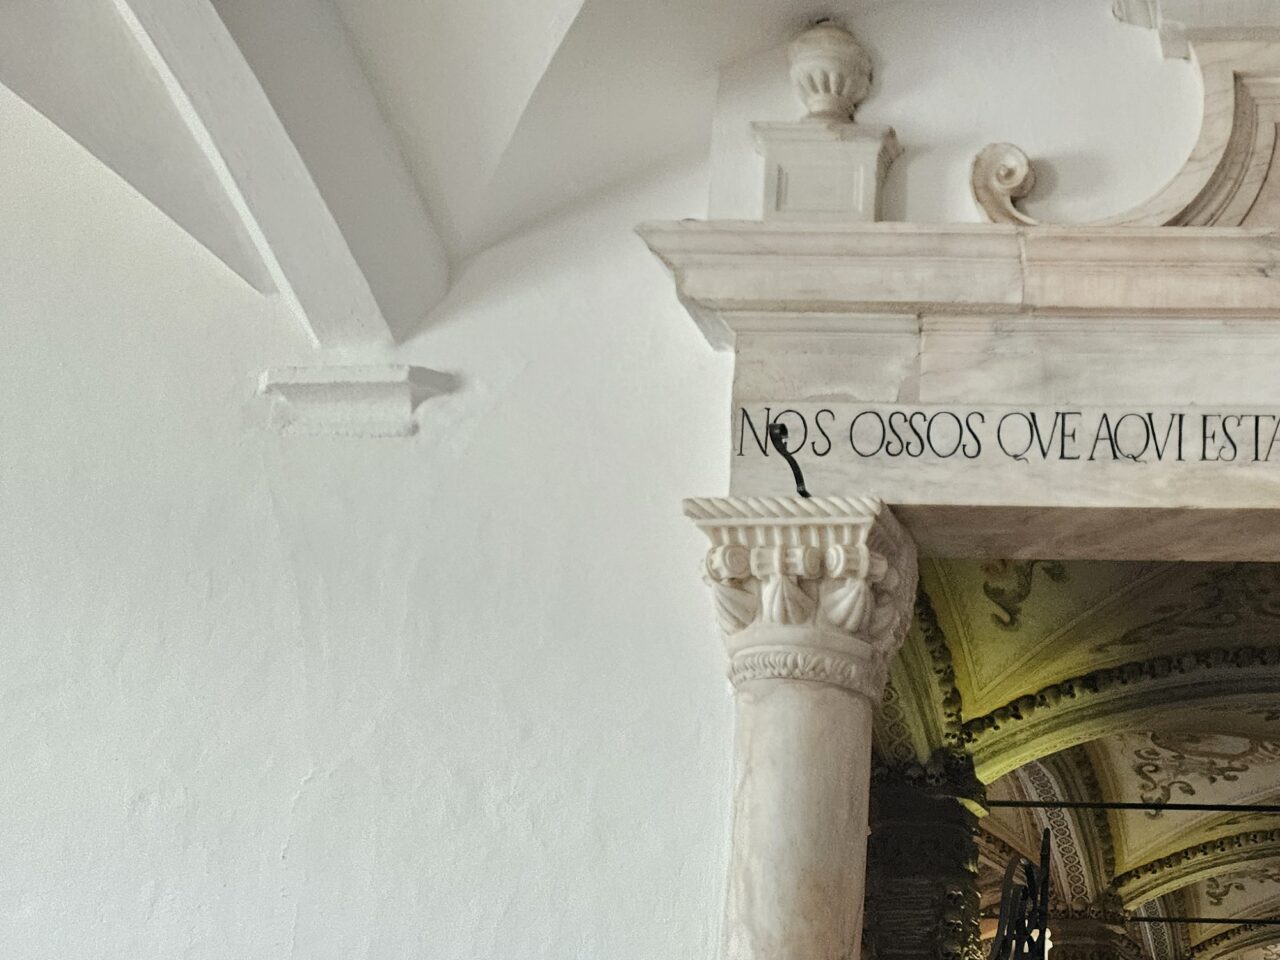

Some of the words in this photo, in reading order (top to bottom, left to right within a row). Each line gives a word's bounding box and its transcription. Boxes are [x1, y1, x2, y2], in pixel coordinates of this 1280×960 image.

[737, 407, 836, 457] NOS
[849, 410, 986, 458] OSSOS
[997, 411, 1081, 464] QVE
[1087, 412, 1187, 465] AQVI
